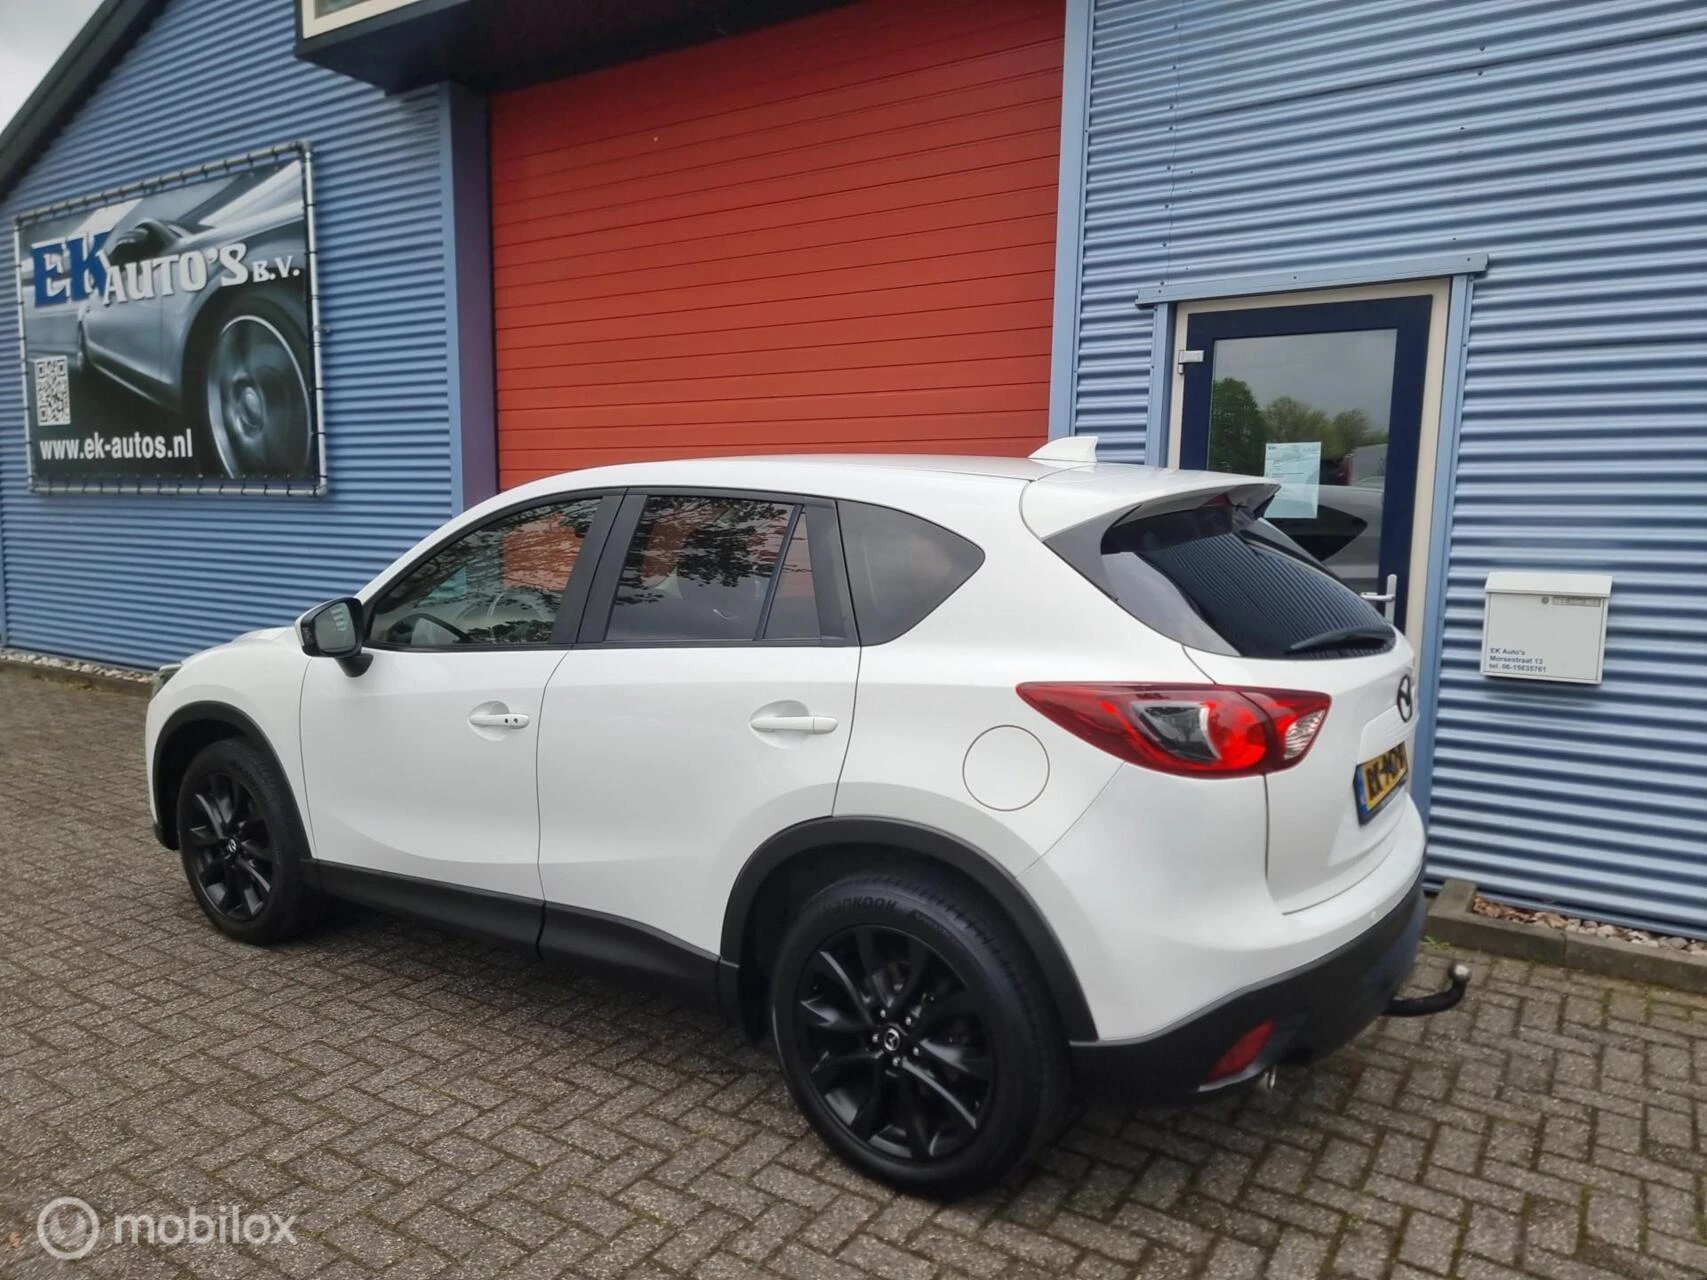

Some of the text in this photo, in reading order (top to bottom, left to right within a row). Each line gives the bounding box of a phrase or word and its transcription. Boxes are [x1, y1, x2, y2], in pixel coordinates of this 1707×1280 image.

[31, 231, 300, 307] EK AUTO'S B.V.
[40, 428, 193, 460] www.ek-autos.nl
